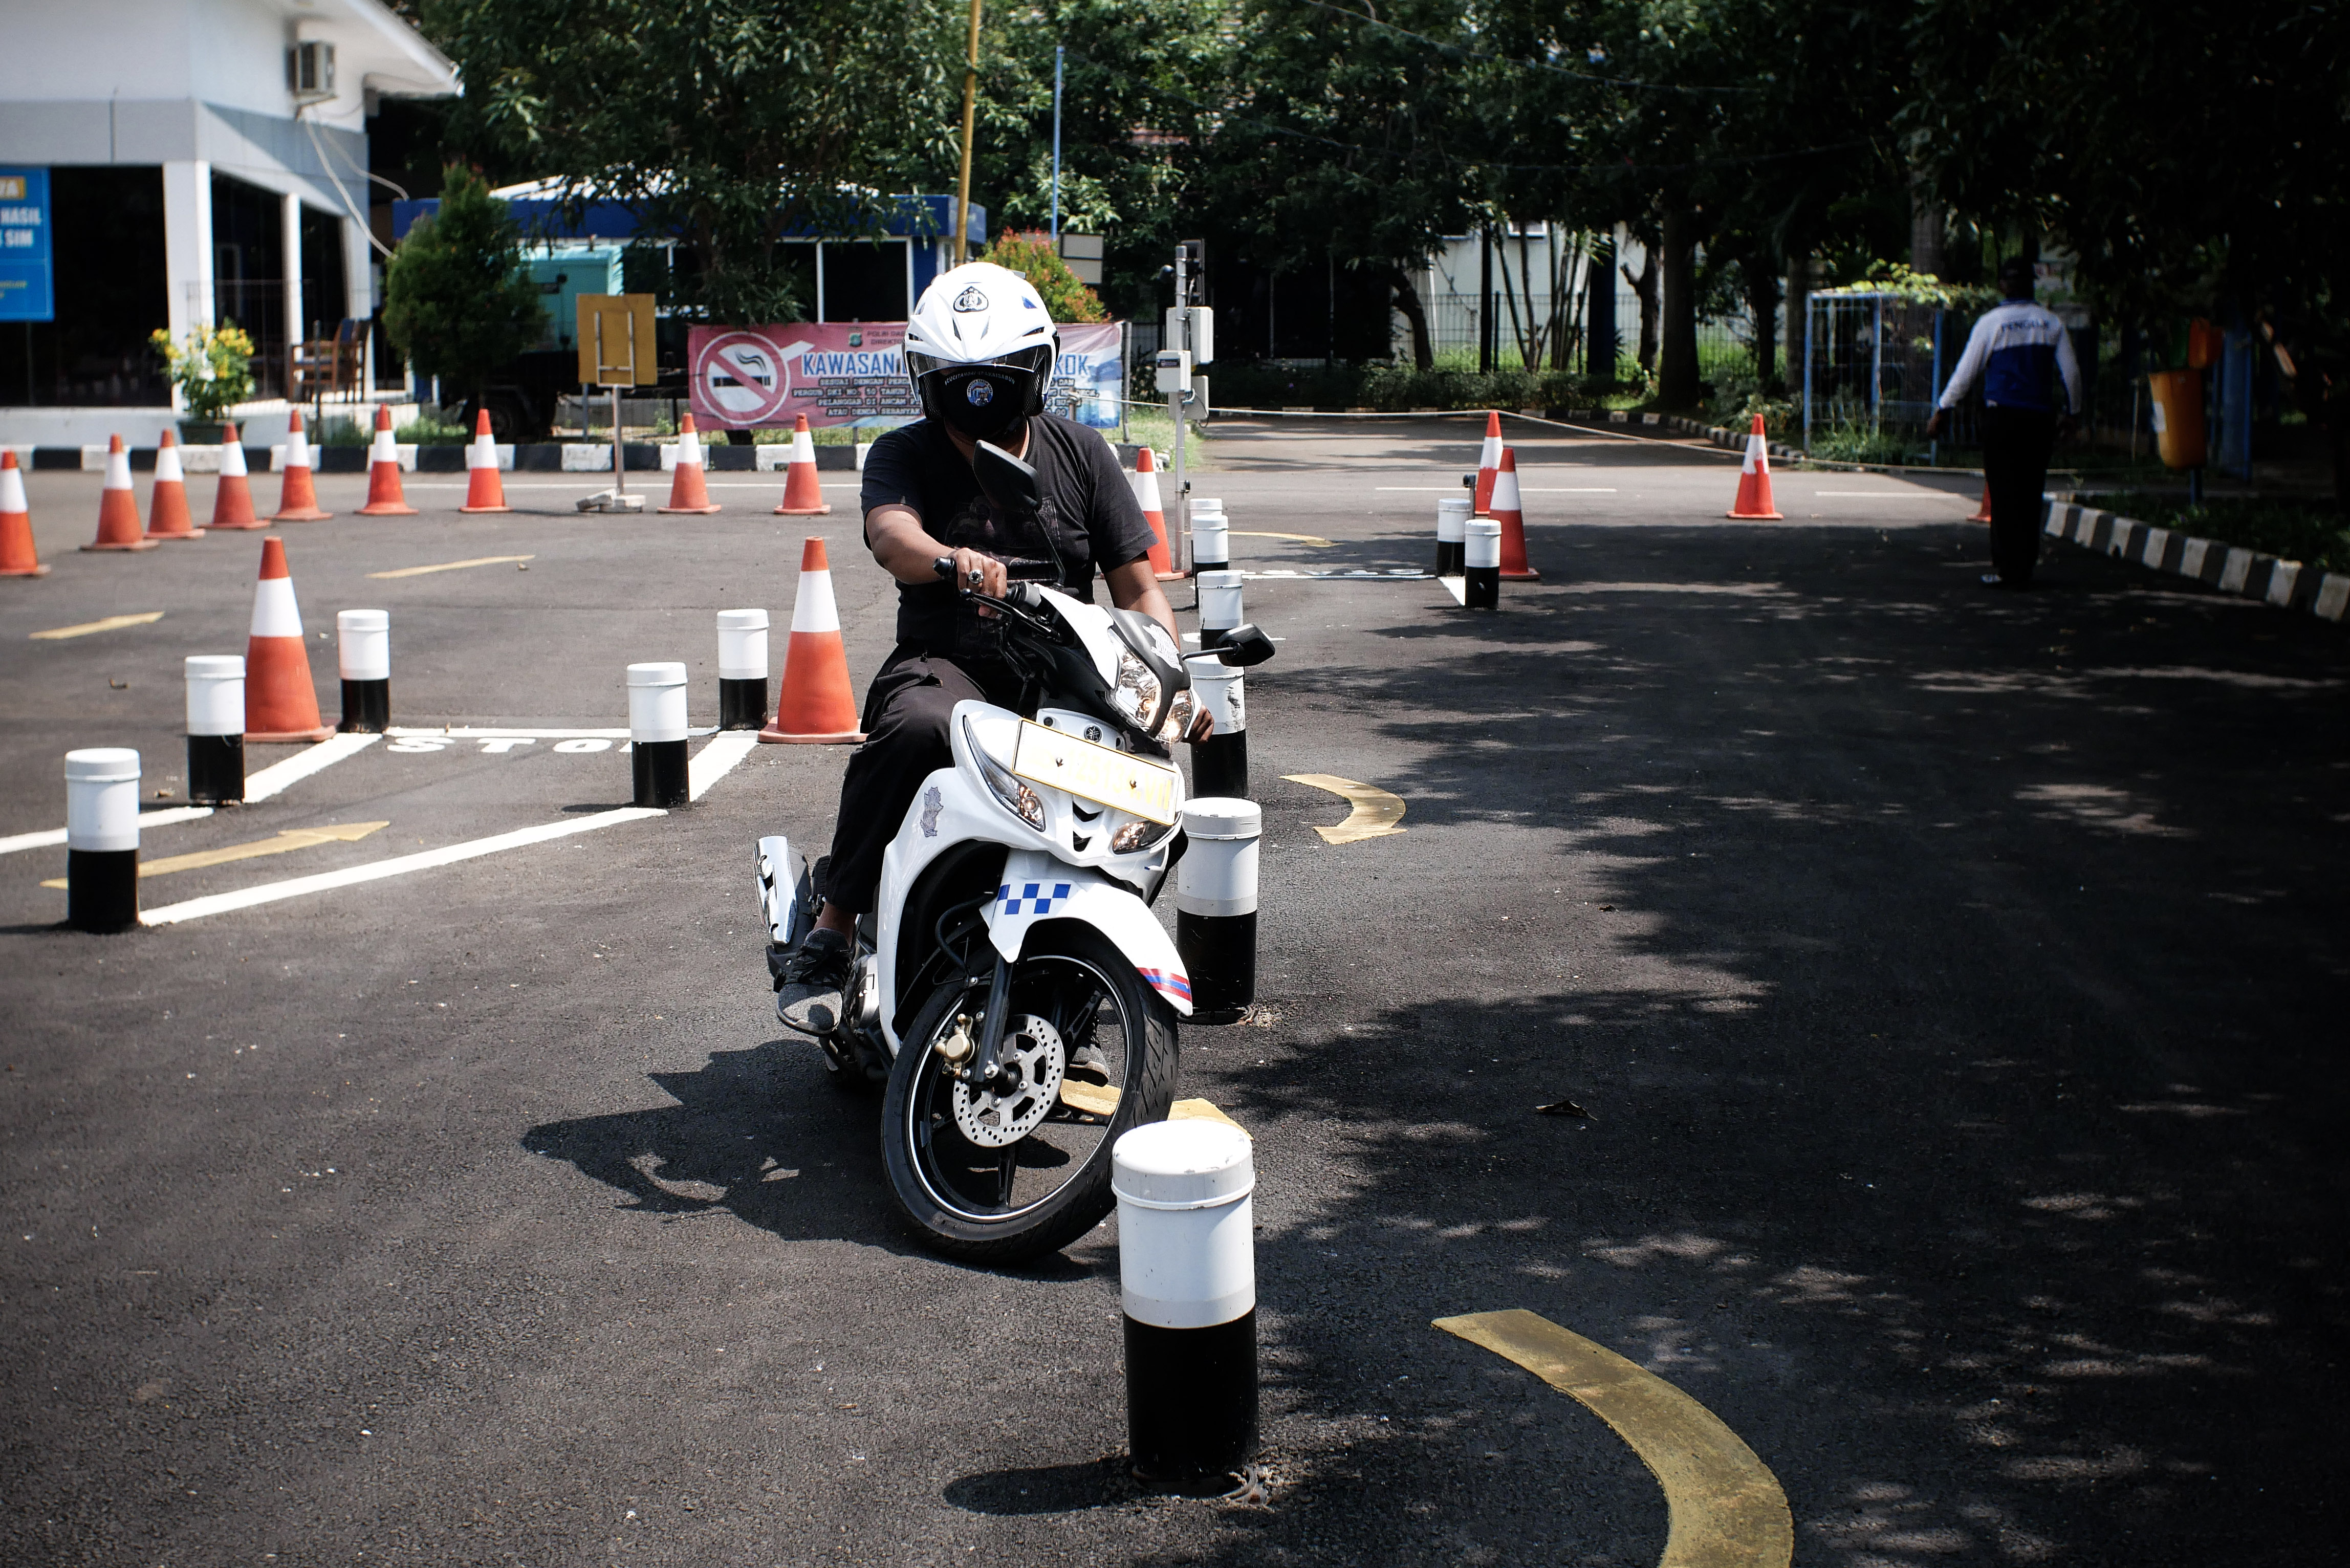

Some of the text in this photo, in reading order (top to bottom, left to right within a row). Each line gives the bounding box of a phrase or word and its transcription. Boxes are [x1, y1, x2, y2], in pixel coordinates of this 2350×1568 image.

[1, 207, 41, 226] HASIL
[4, 229, 34, 248] SIM
[802, 353, 895, 375] KAWASAN
[387, 736, 633, 753] STO
